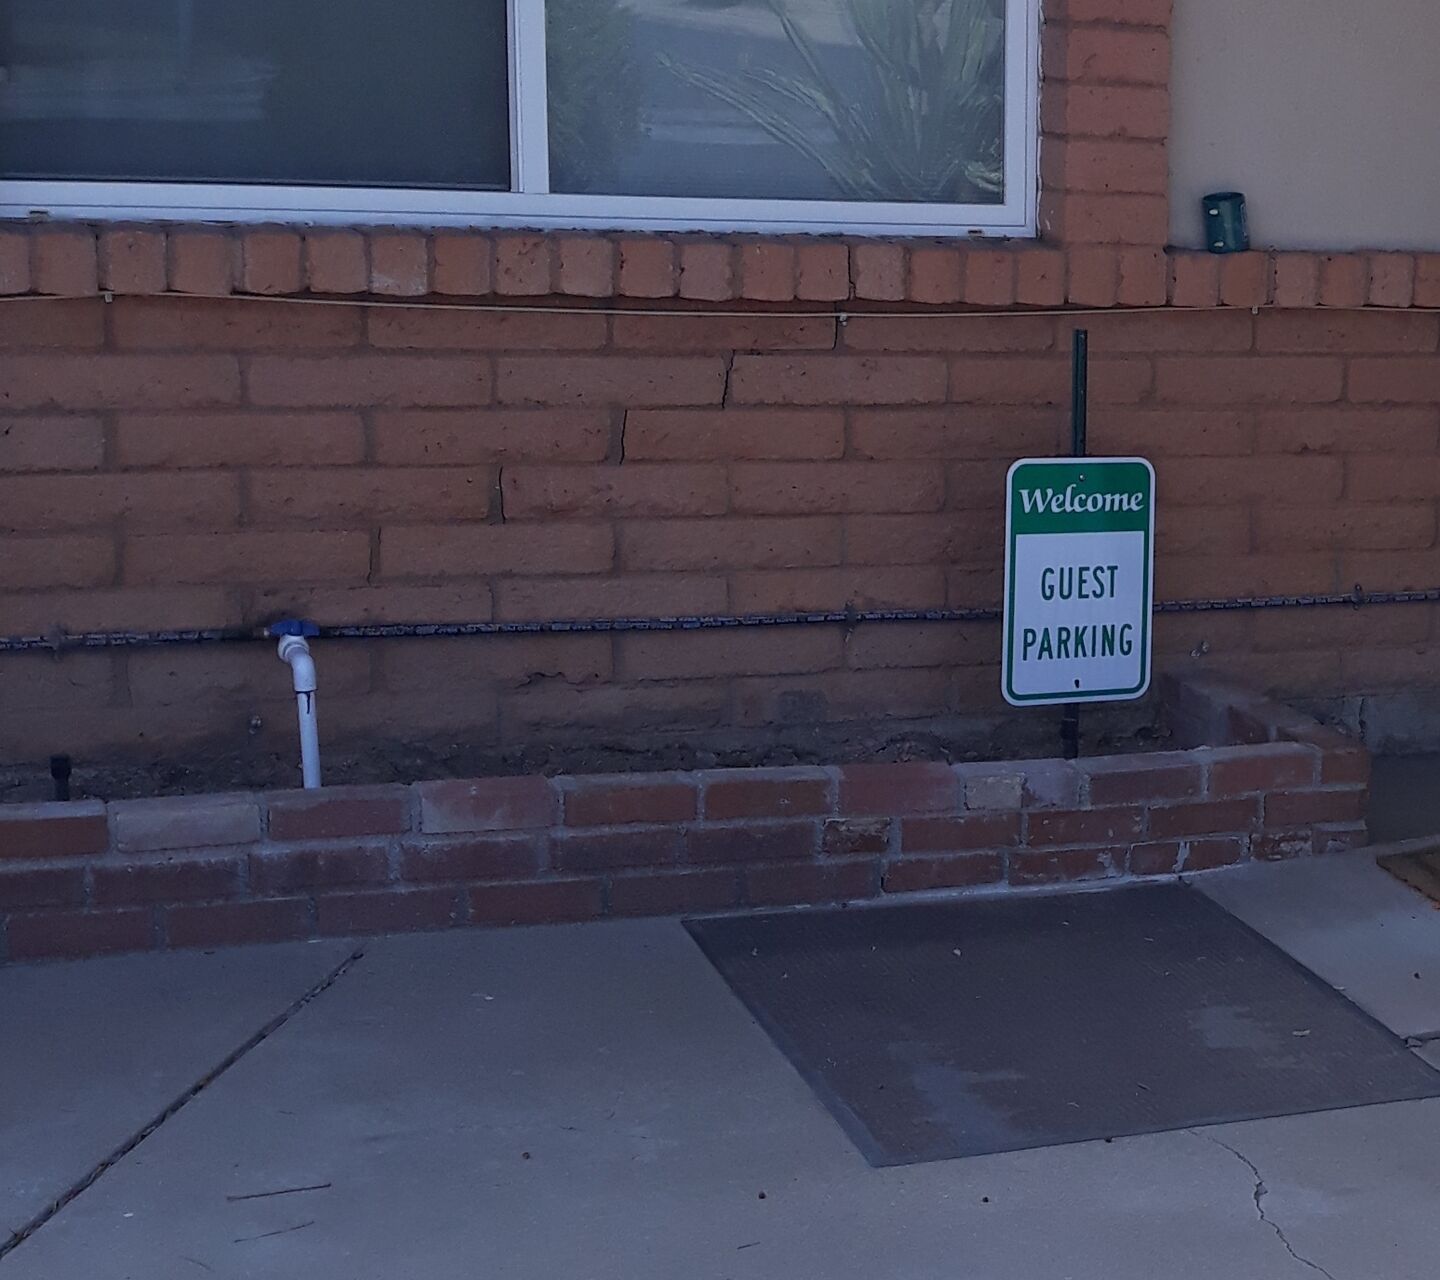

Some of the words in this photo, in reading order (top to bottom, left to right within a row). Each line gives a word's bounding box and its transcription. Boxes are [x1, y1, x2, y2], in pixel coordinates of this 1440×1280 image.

[1018, 484, 1144, 513] Welcome
[1041, 565, 1118, 600] GUEST
[1022, 623, 1133, 661] PARKING
